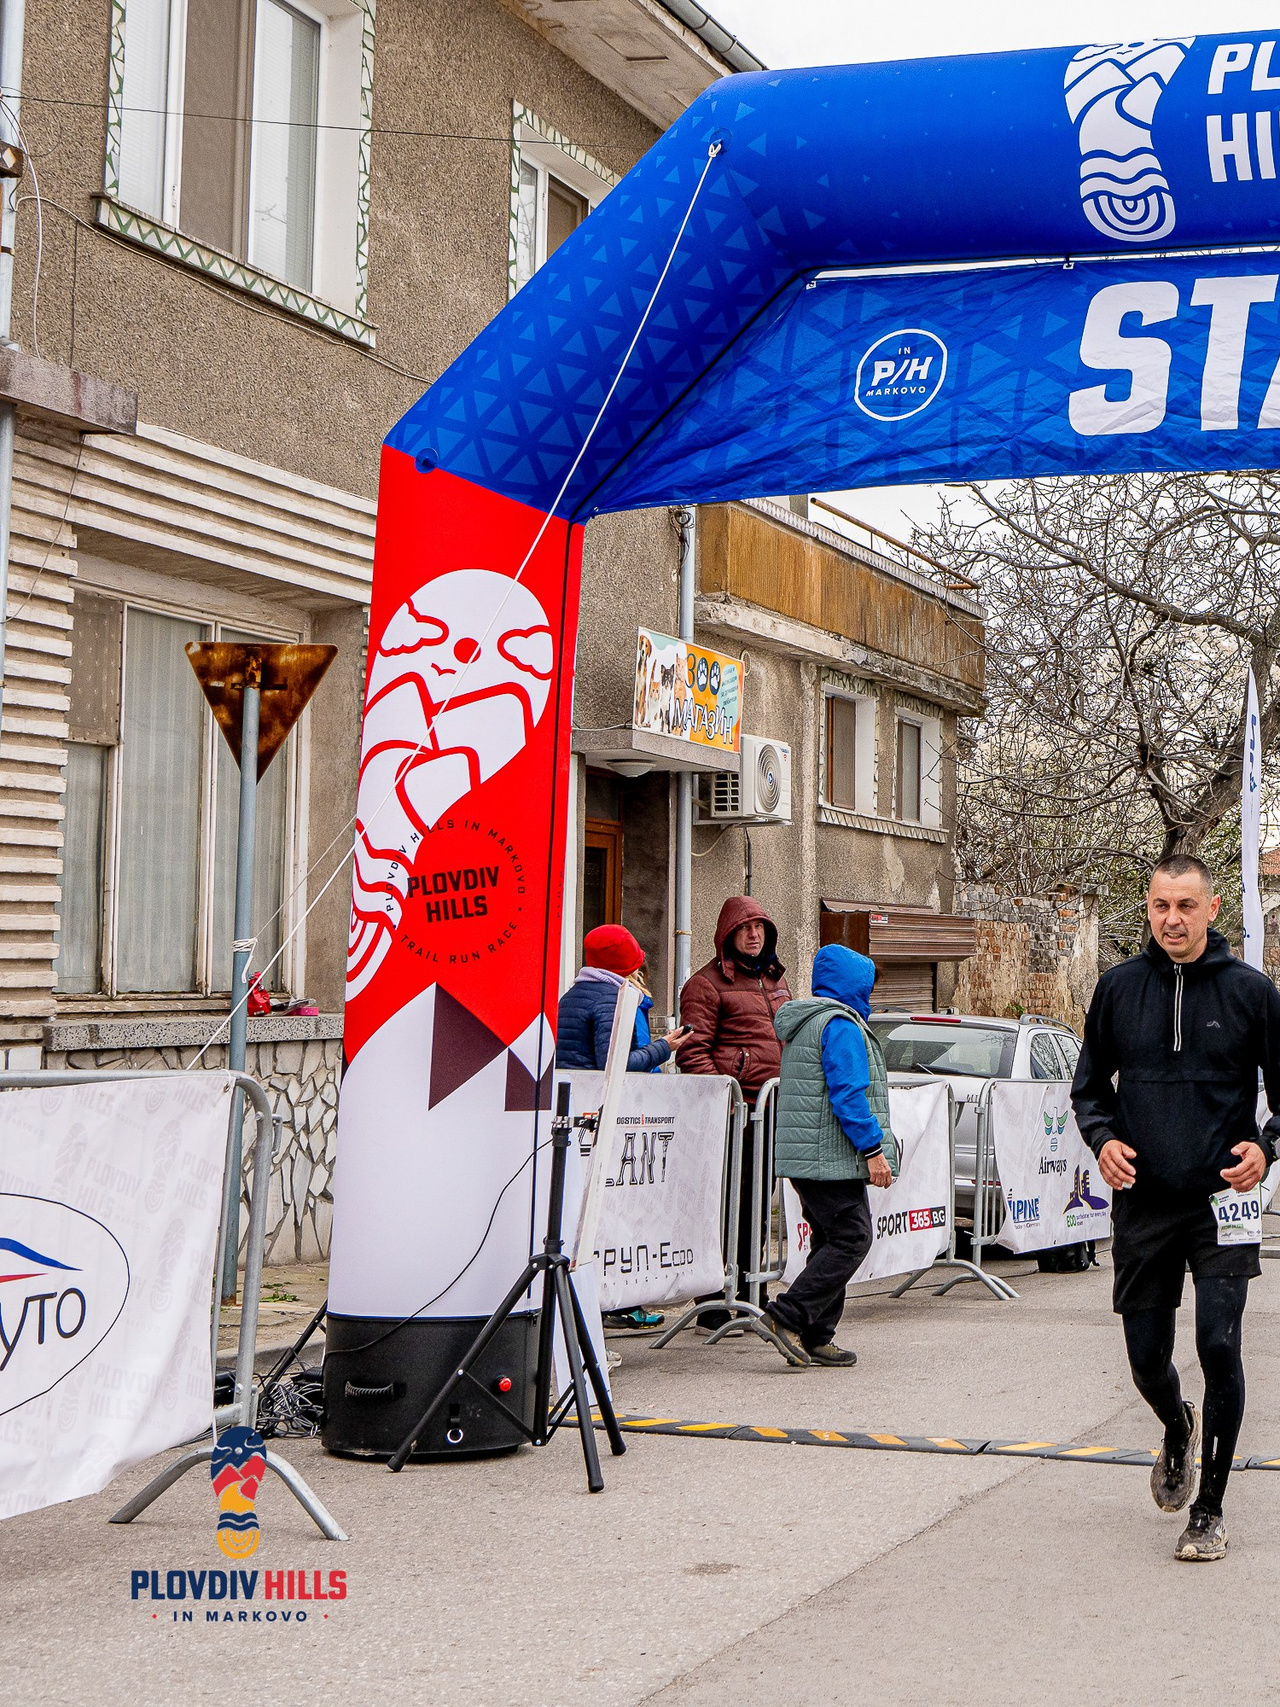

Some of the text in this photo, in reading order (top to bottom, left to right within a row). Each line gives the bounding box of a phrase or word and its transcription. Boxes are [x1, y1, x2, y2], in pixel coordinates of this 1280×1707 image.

[898, 346, 911, 355] IN
[871, 356, 934, 387] P/H
[865, 386, 926, 397] MARKOVO
[674, 697, 733, 744] МАГАЗИН
[385, 819, 525, 912] PLOVDIV HILLS IN MARKOVO
[407, 866, 499, 898] PLOVDIV
[426, 895, 488, 923] HILLS
[401, 922, 517, 964] TRAIL RUN RACE
[1038, 1156, 1068, 1177] Airways
[1218, 1200, 1260, 1222] 4249
